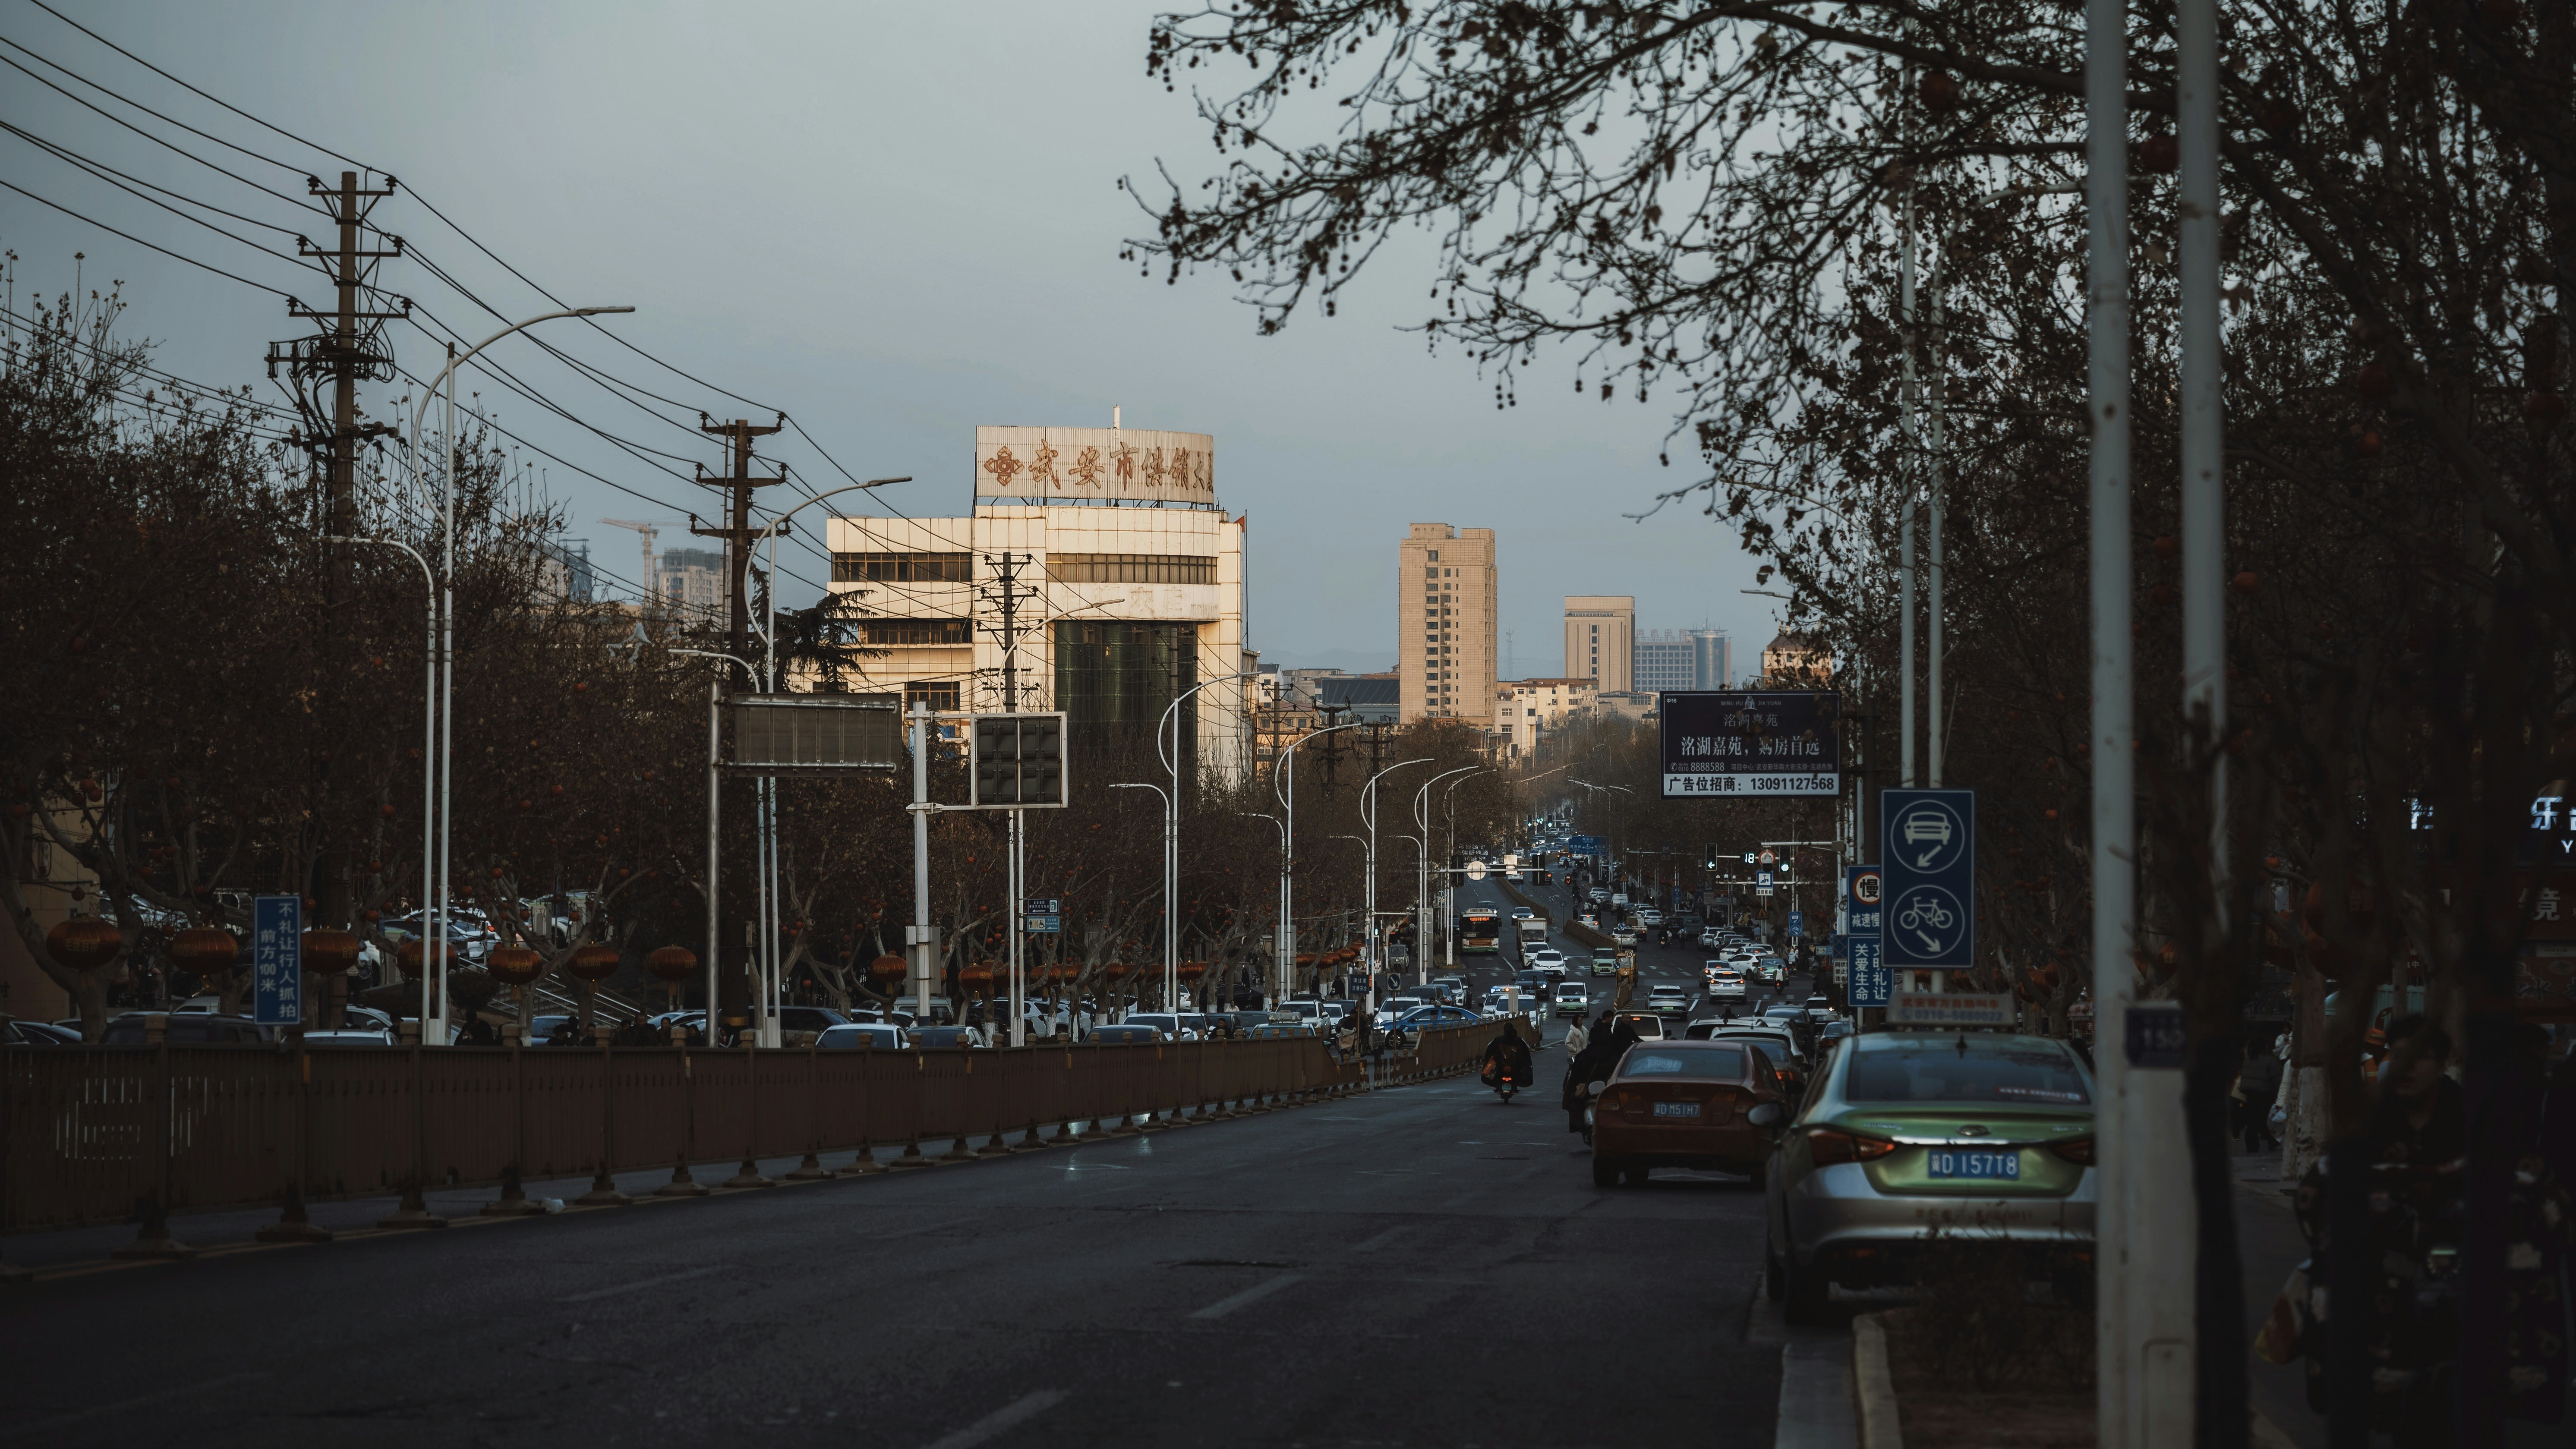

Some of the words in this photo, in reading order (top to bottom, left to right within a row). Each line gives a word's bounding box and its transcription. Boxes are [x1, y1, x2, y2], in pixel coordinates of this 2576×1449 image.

[1690, 762, 1725, 772] 8888588
[1750, 778, 1834, 790] 13091127568
[2531, 797, 2576, 831] 乐
[1745, 853, 1755, 863] 18
[1860, 879, 1879, 898] 慢
[279, 903, 296, 1017] 不礼让行人抓拍
[1855, 944, 1869, 1001] 关爱生命
